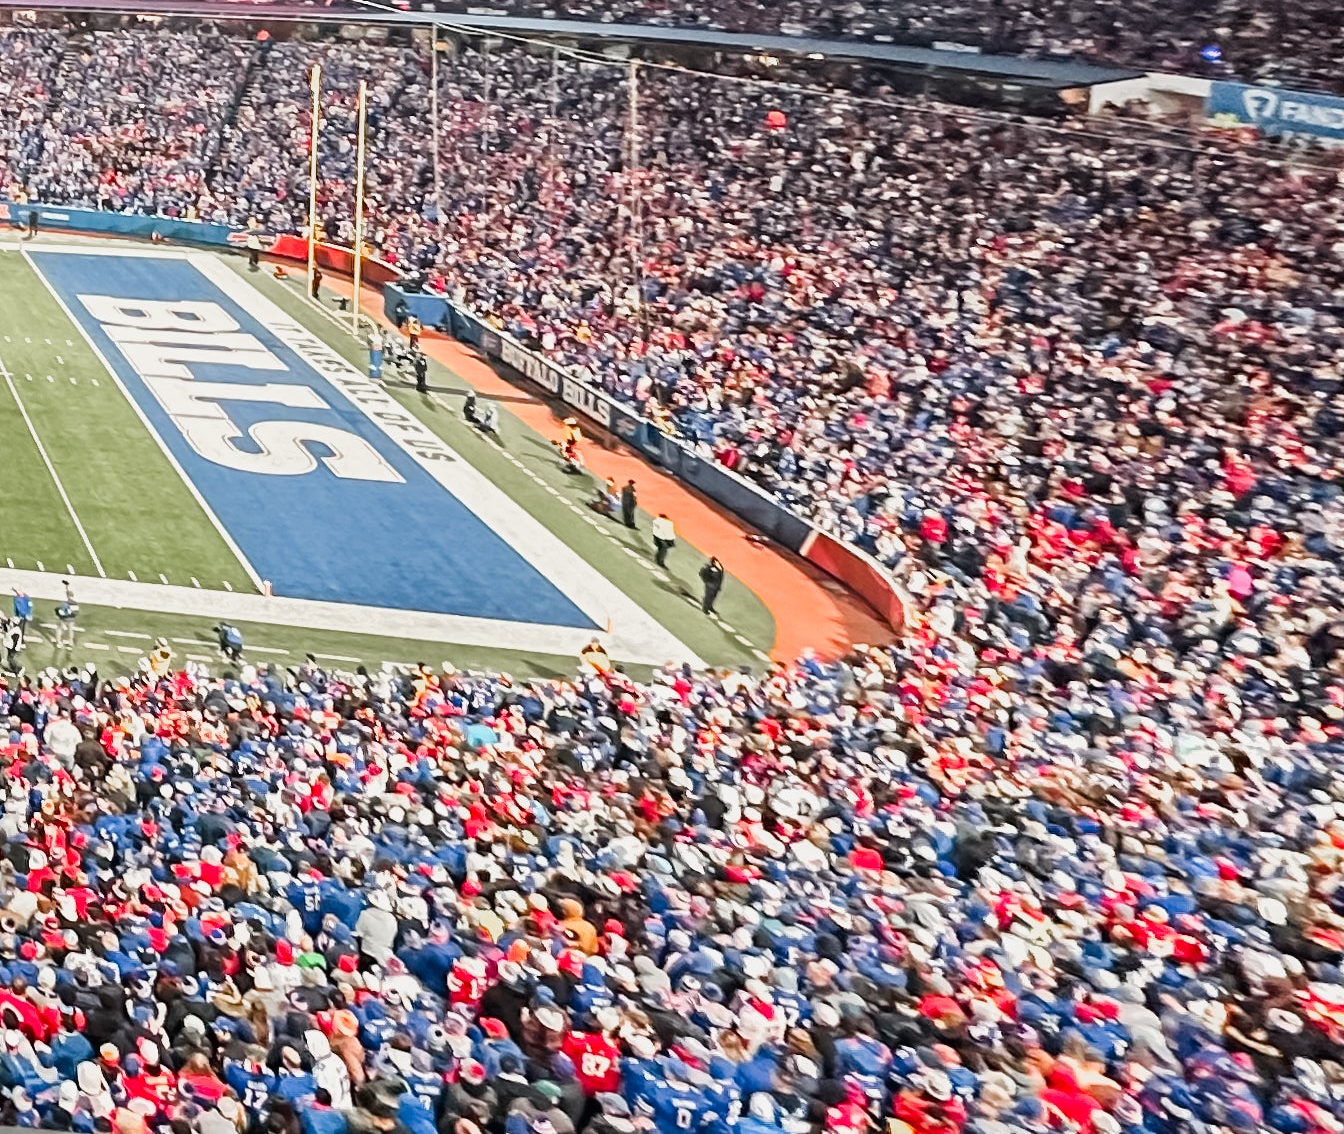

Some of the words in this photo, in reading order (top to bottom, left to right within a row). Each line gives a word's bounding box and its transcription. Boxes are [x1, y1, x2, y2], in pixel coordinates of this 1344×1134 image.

[76, 294, 407, 483] BILLS
[287, 338, 355, 373] TAKES
[336, 378, 390, 405] ALL
[373, 412, 424, 434] OF
[403, 438, 457, 462] US
[562, 377, 611, 429] BILLS
